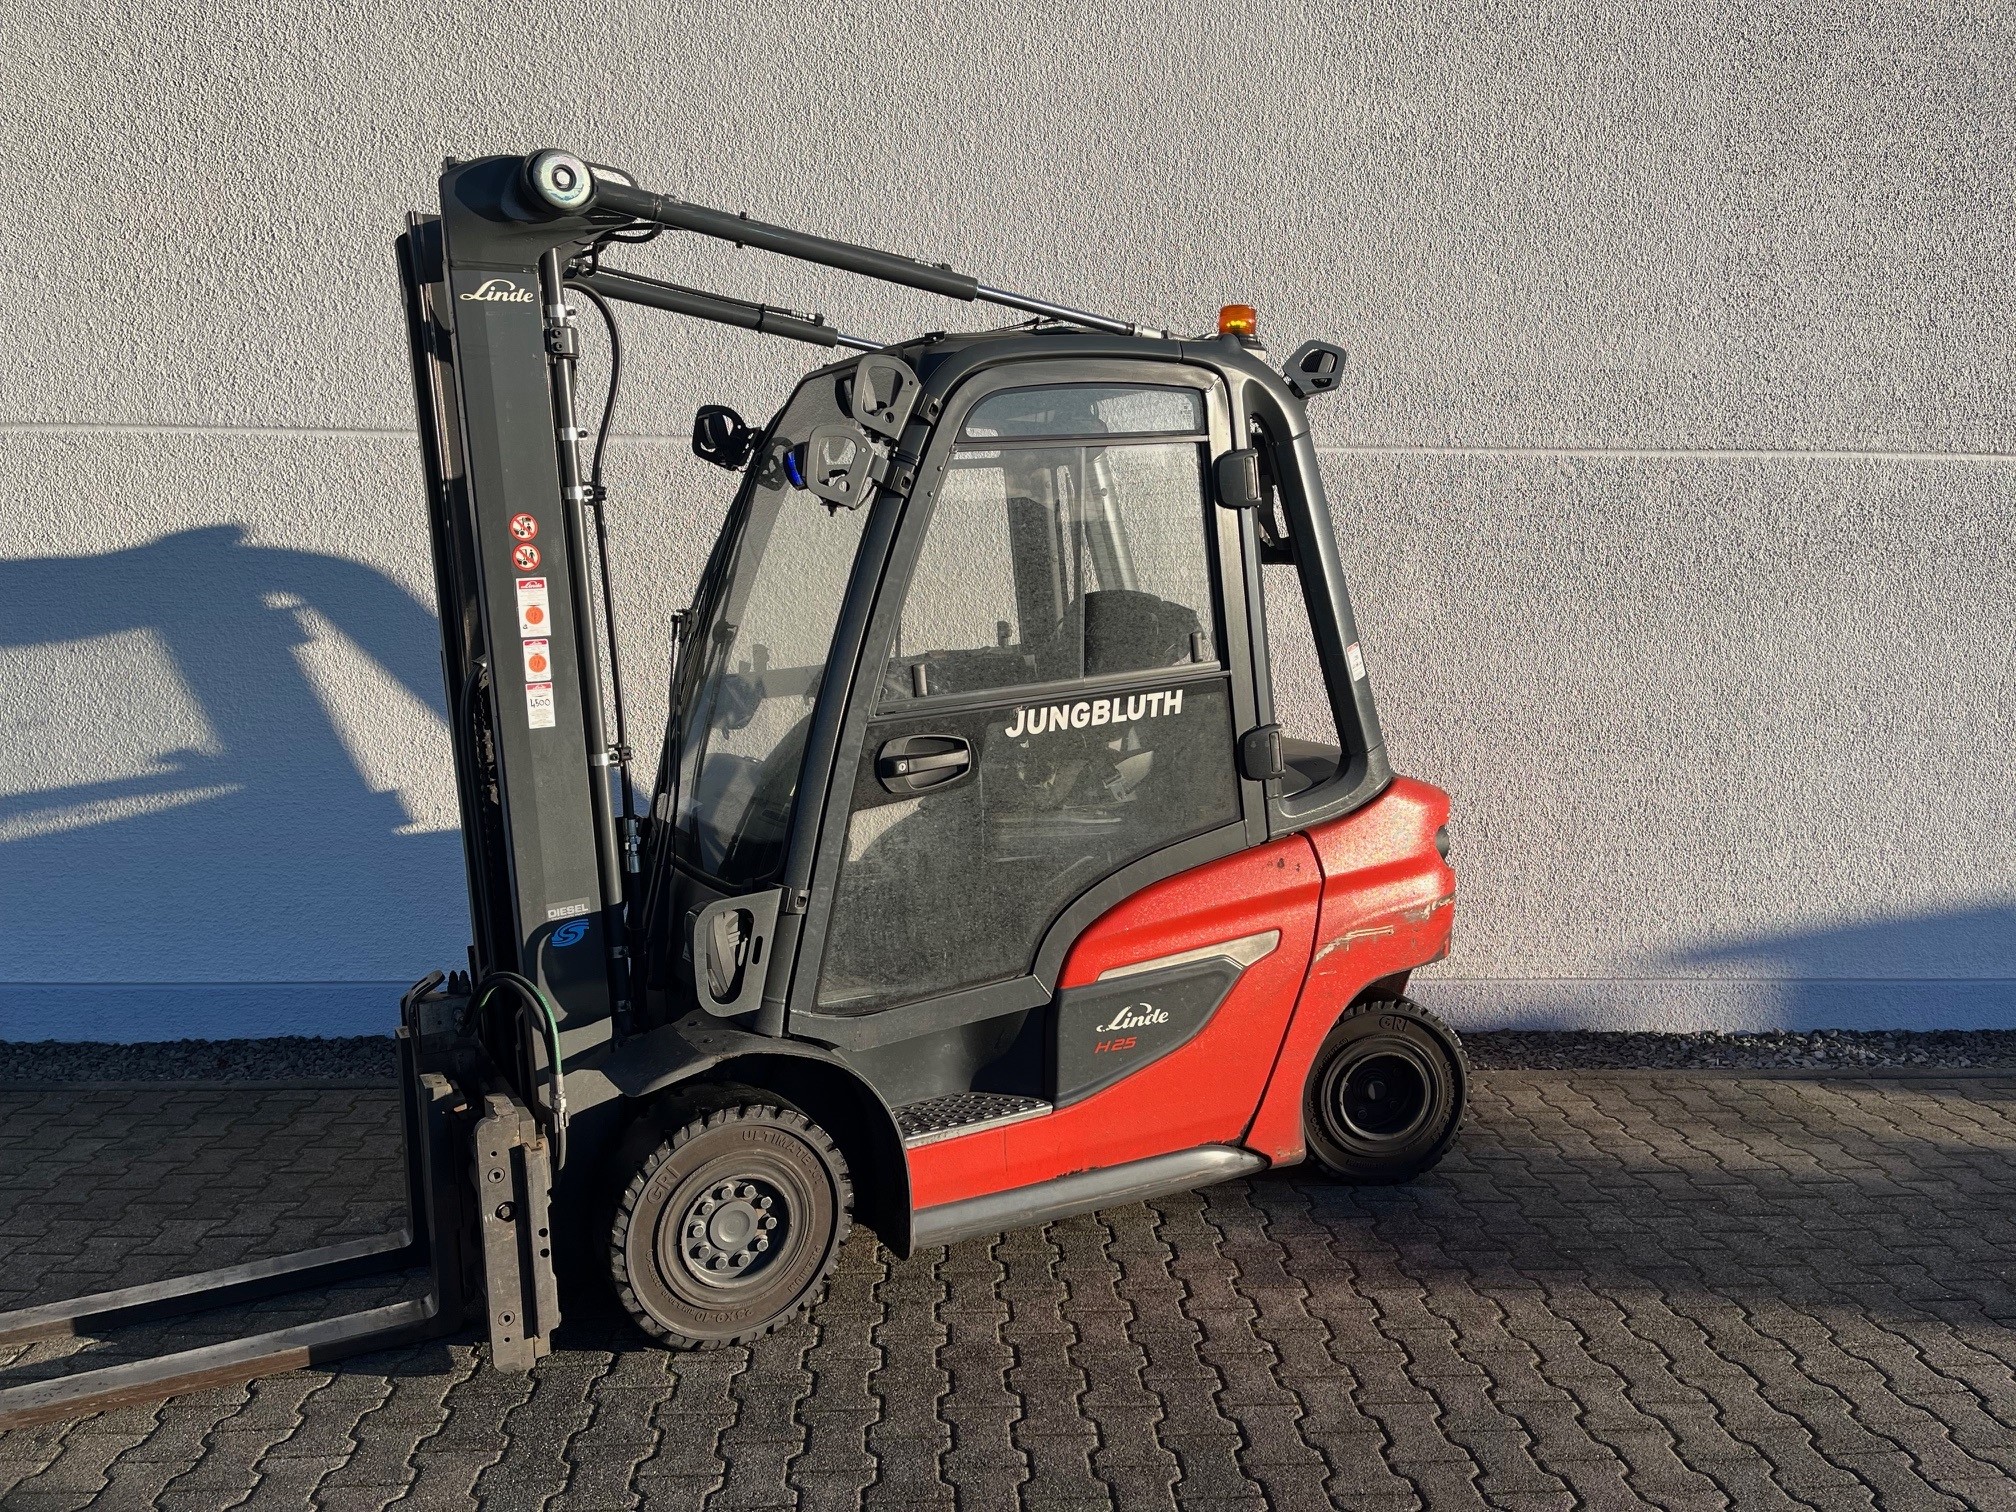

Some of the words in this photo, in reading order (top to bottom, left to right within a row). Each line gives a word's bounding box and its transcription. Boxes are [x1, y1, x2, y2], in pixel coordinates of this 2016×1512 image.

[459, 278, 535, 303] Linde
[1004, 689, 1184, 738] JUNGBLUTH
[547, 903, 589, 919] DIESEL
[1095, 1002, 1169, 1033] Linde
[1378, 1016, 1409, 1032] GRI
[742, 1130, 813, 1166] ULTIMATE
[645, 1164, 681, 1205] GRI
